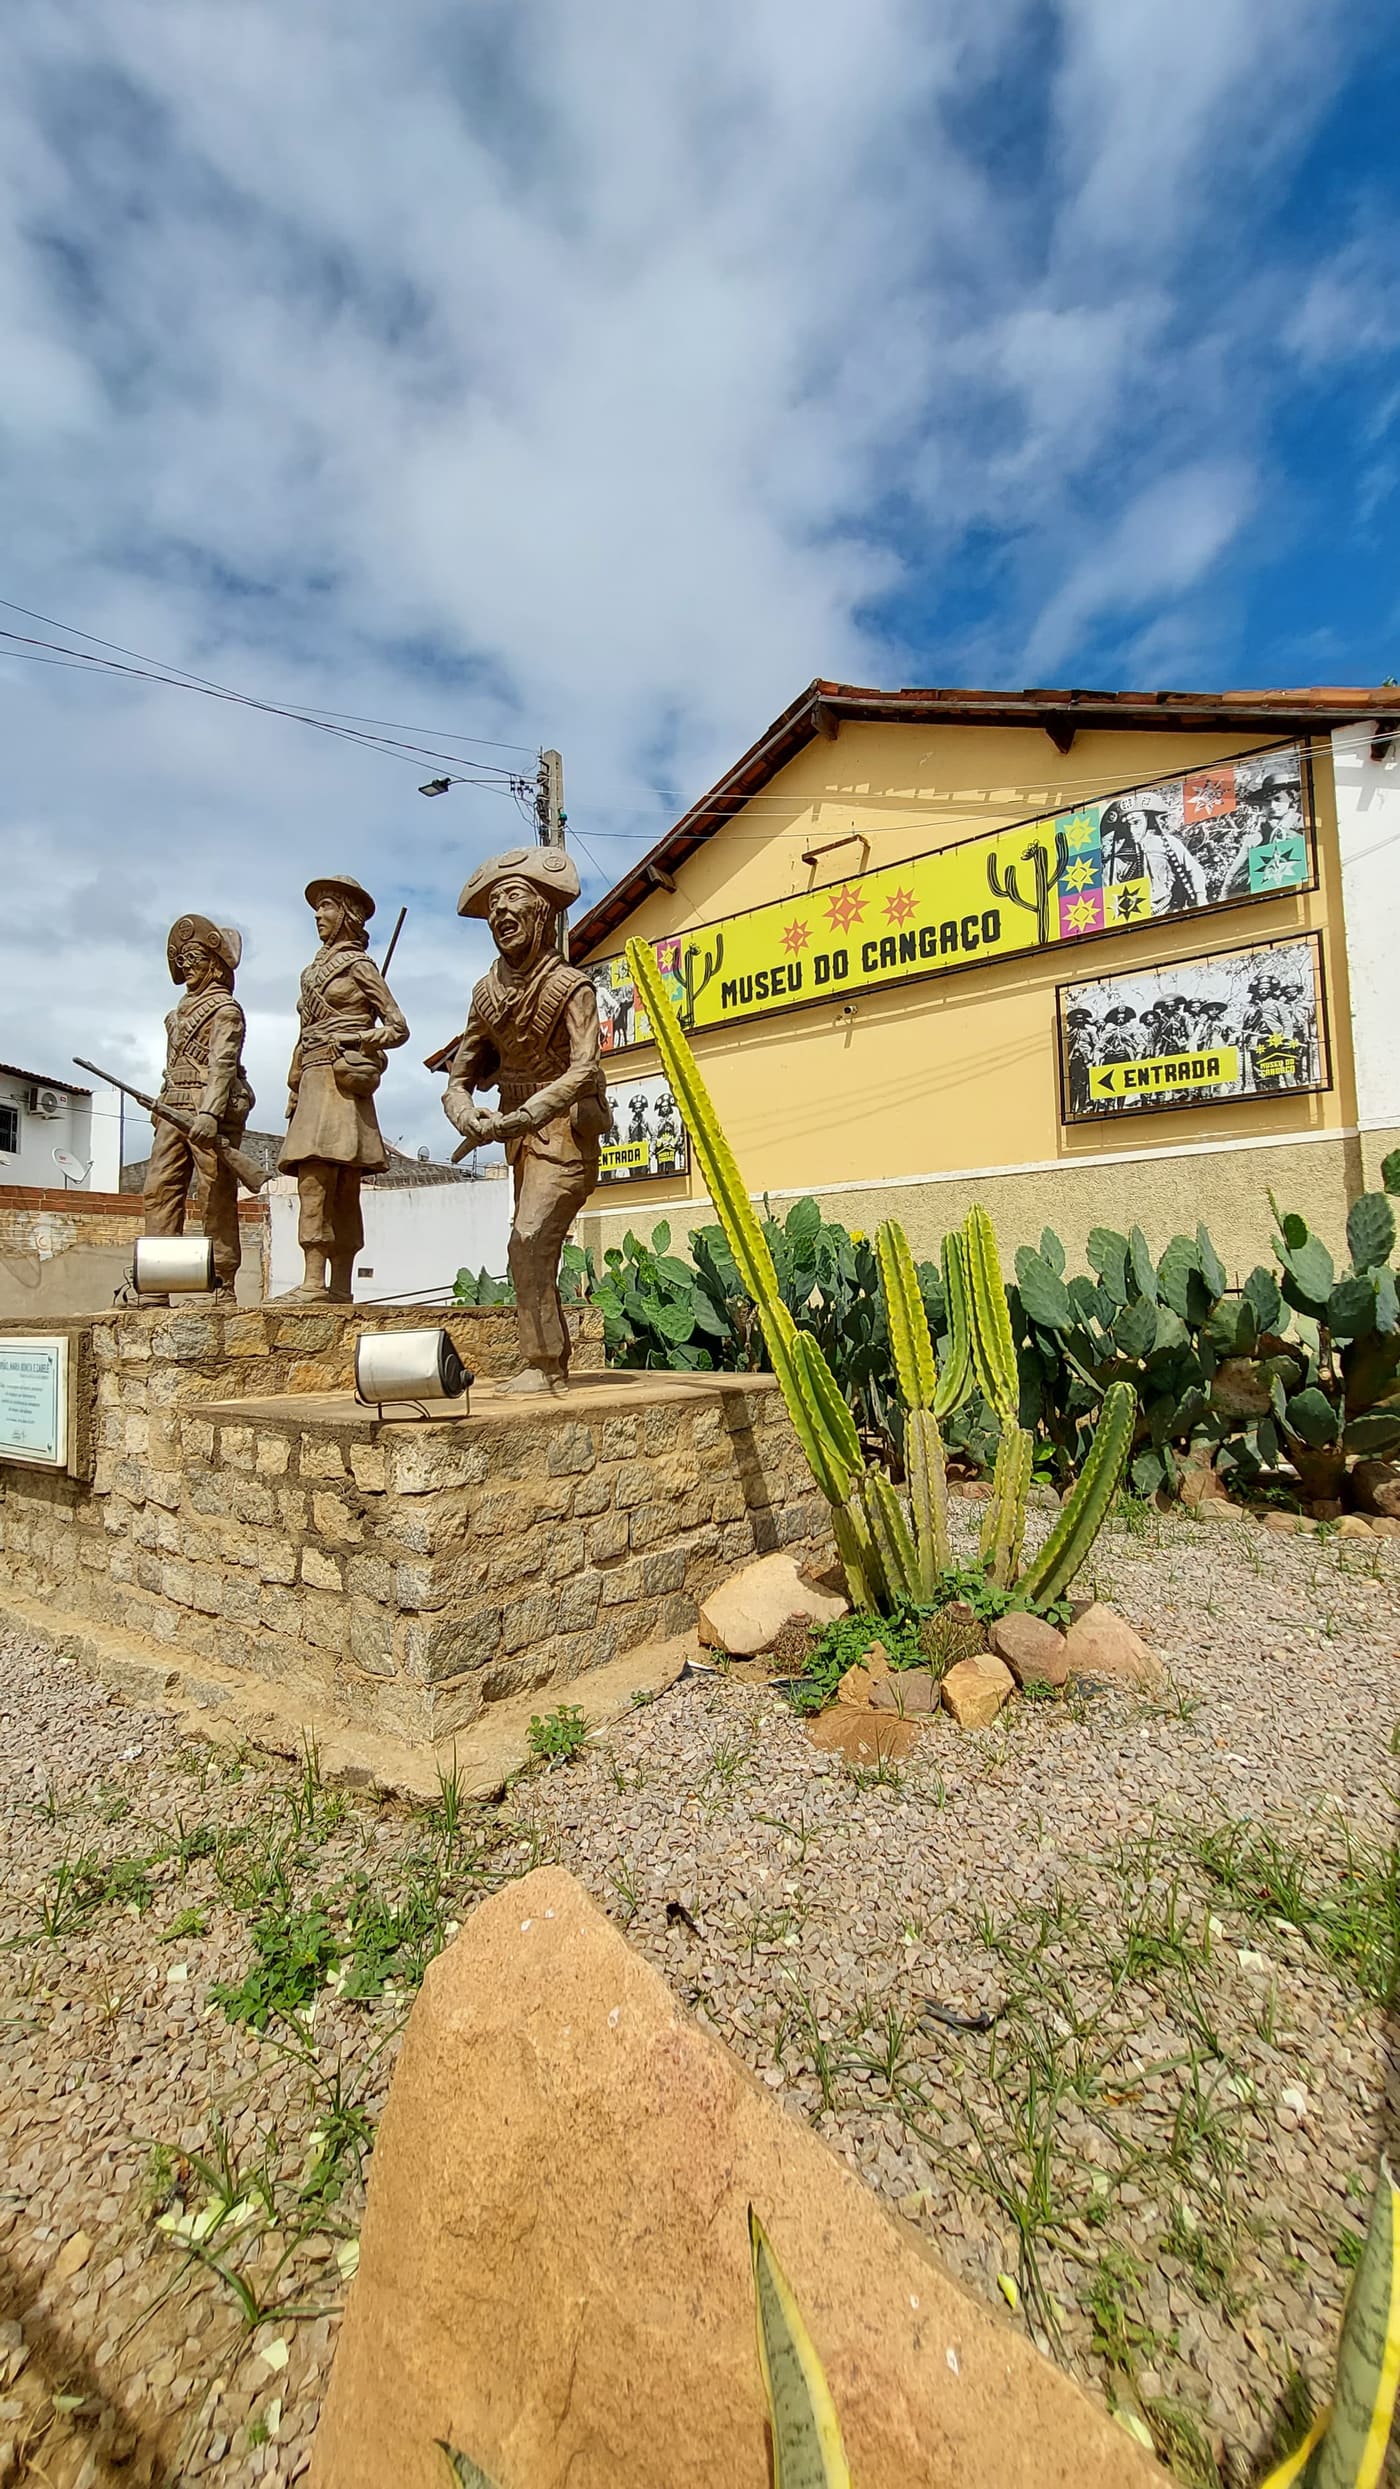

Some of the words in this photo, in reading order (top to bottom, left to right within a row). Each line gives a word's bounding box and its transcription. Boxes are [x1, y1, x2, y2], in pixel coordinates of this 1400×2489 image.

[721, 961, 803, 1009] MUSEU
[814, 949, 849, 985] DO
[861, 909, 1001, 973] CANGAÇO
[1123, 1057, 1221, 1089] ENTRADA
